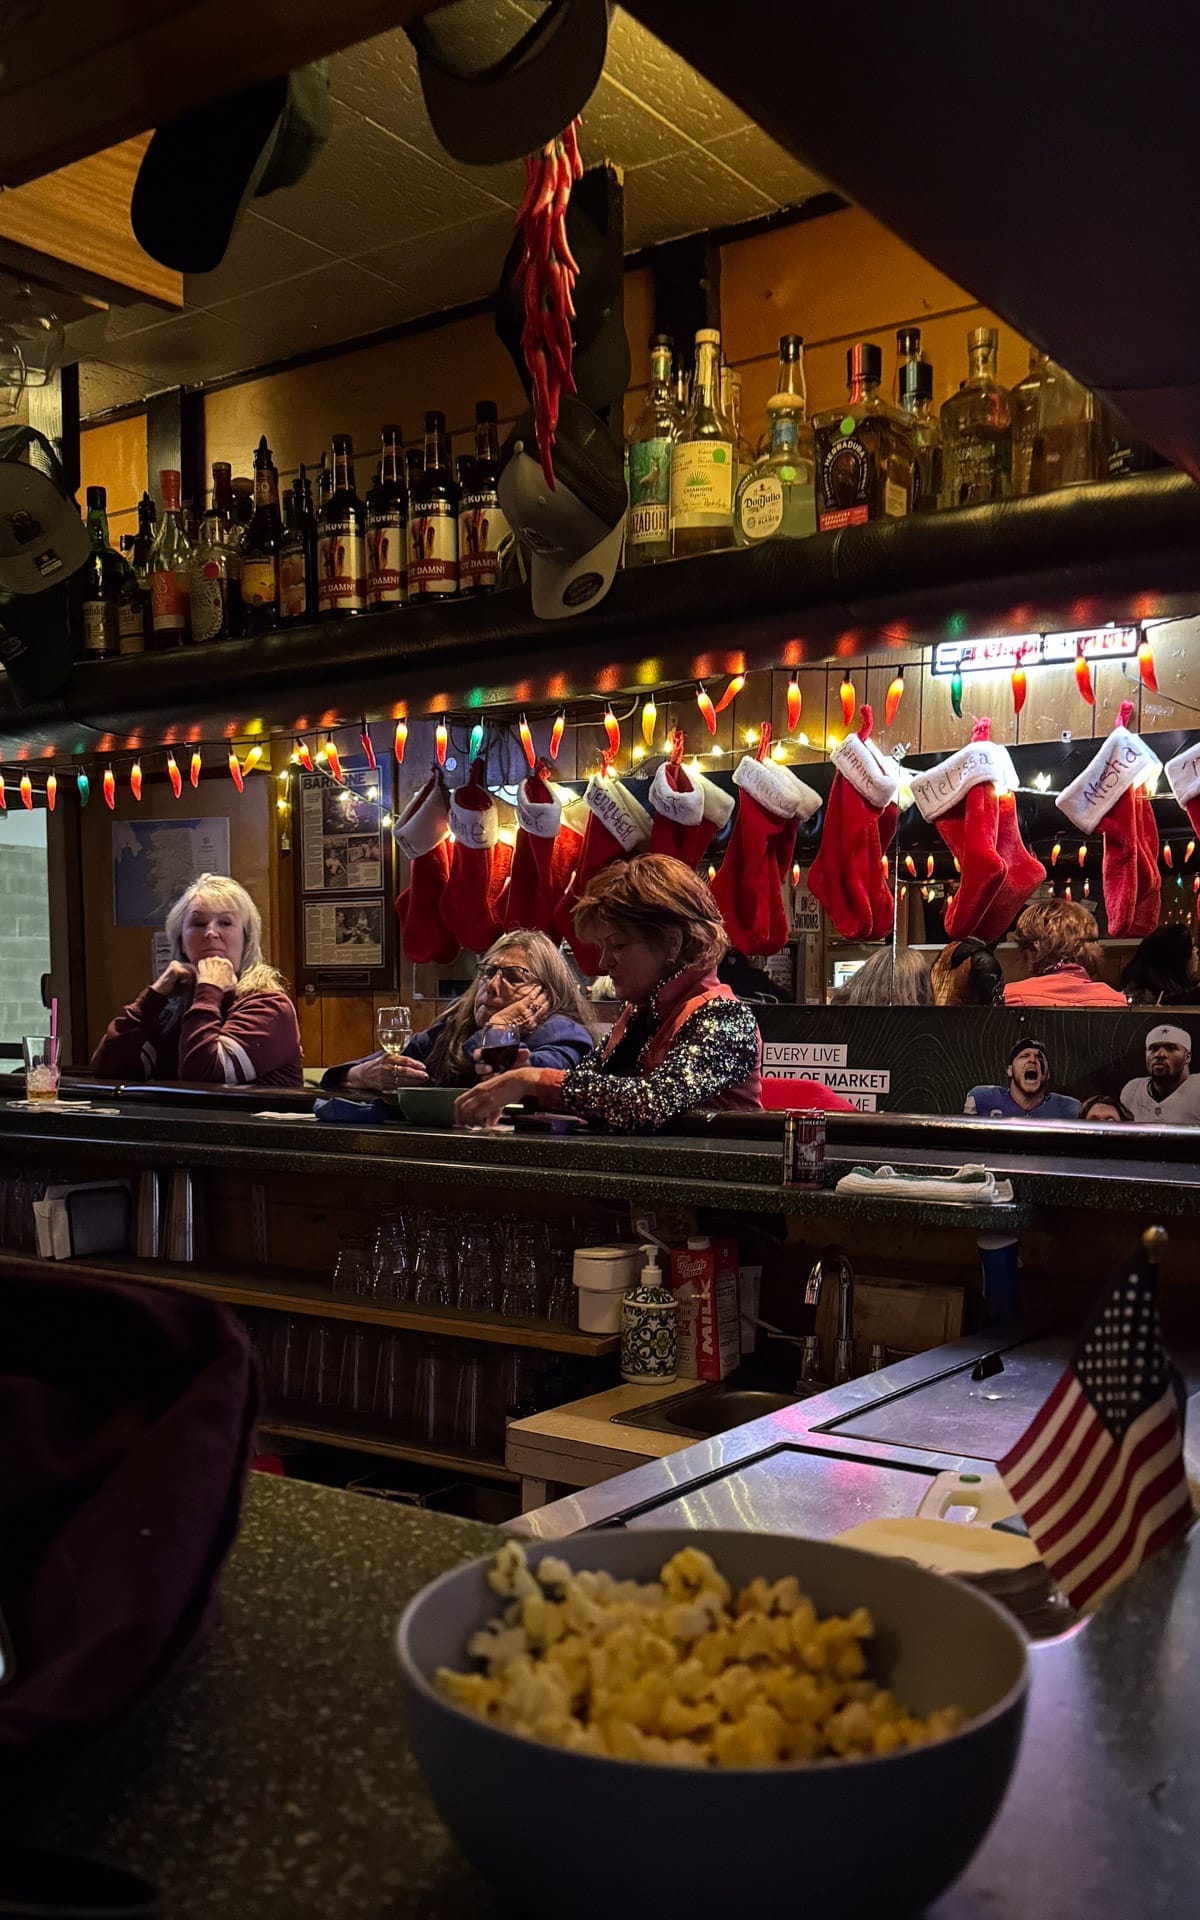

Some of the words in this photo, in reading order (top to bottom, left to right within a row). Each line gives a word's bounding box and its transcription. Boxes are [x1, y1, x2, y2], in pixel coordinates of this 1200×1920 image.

[823, 440, 865, 466] HERRADURA
[414, 502, 451, 511] KUYPER
[370, 514, 400, 524] KUYPE
[325, 522, 353, 532] KUYP
[471, 559, 497, 569] DAMN
[918, 753, 992, 802] Melissa
[765, 1047, 809, 1060] EVERY
[813, 1048, 841, 1062] LIVE
[824, 1073, 888, 1088] MARKET
[700, 1278, 713, 1356] MILK
